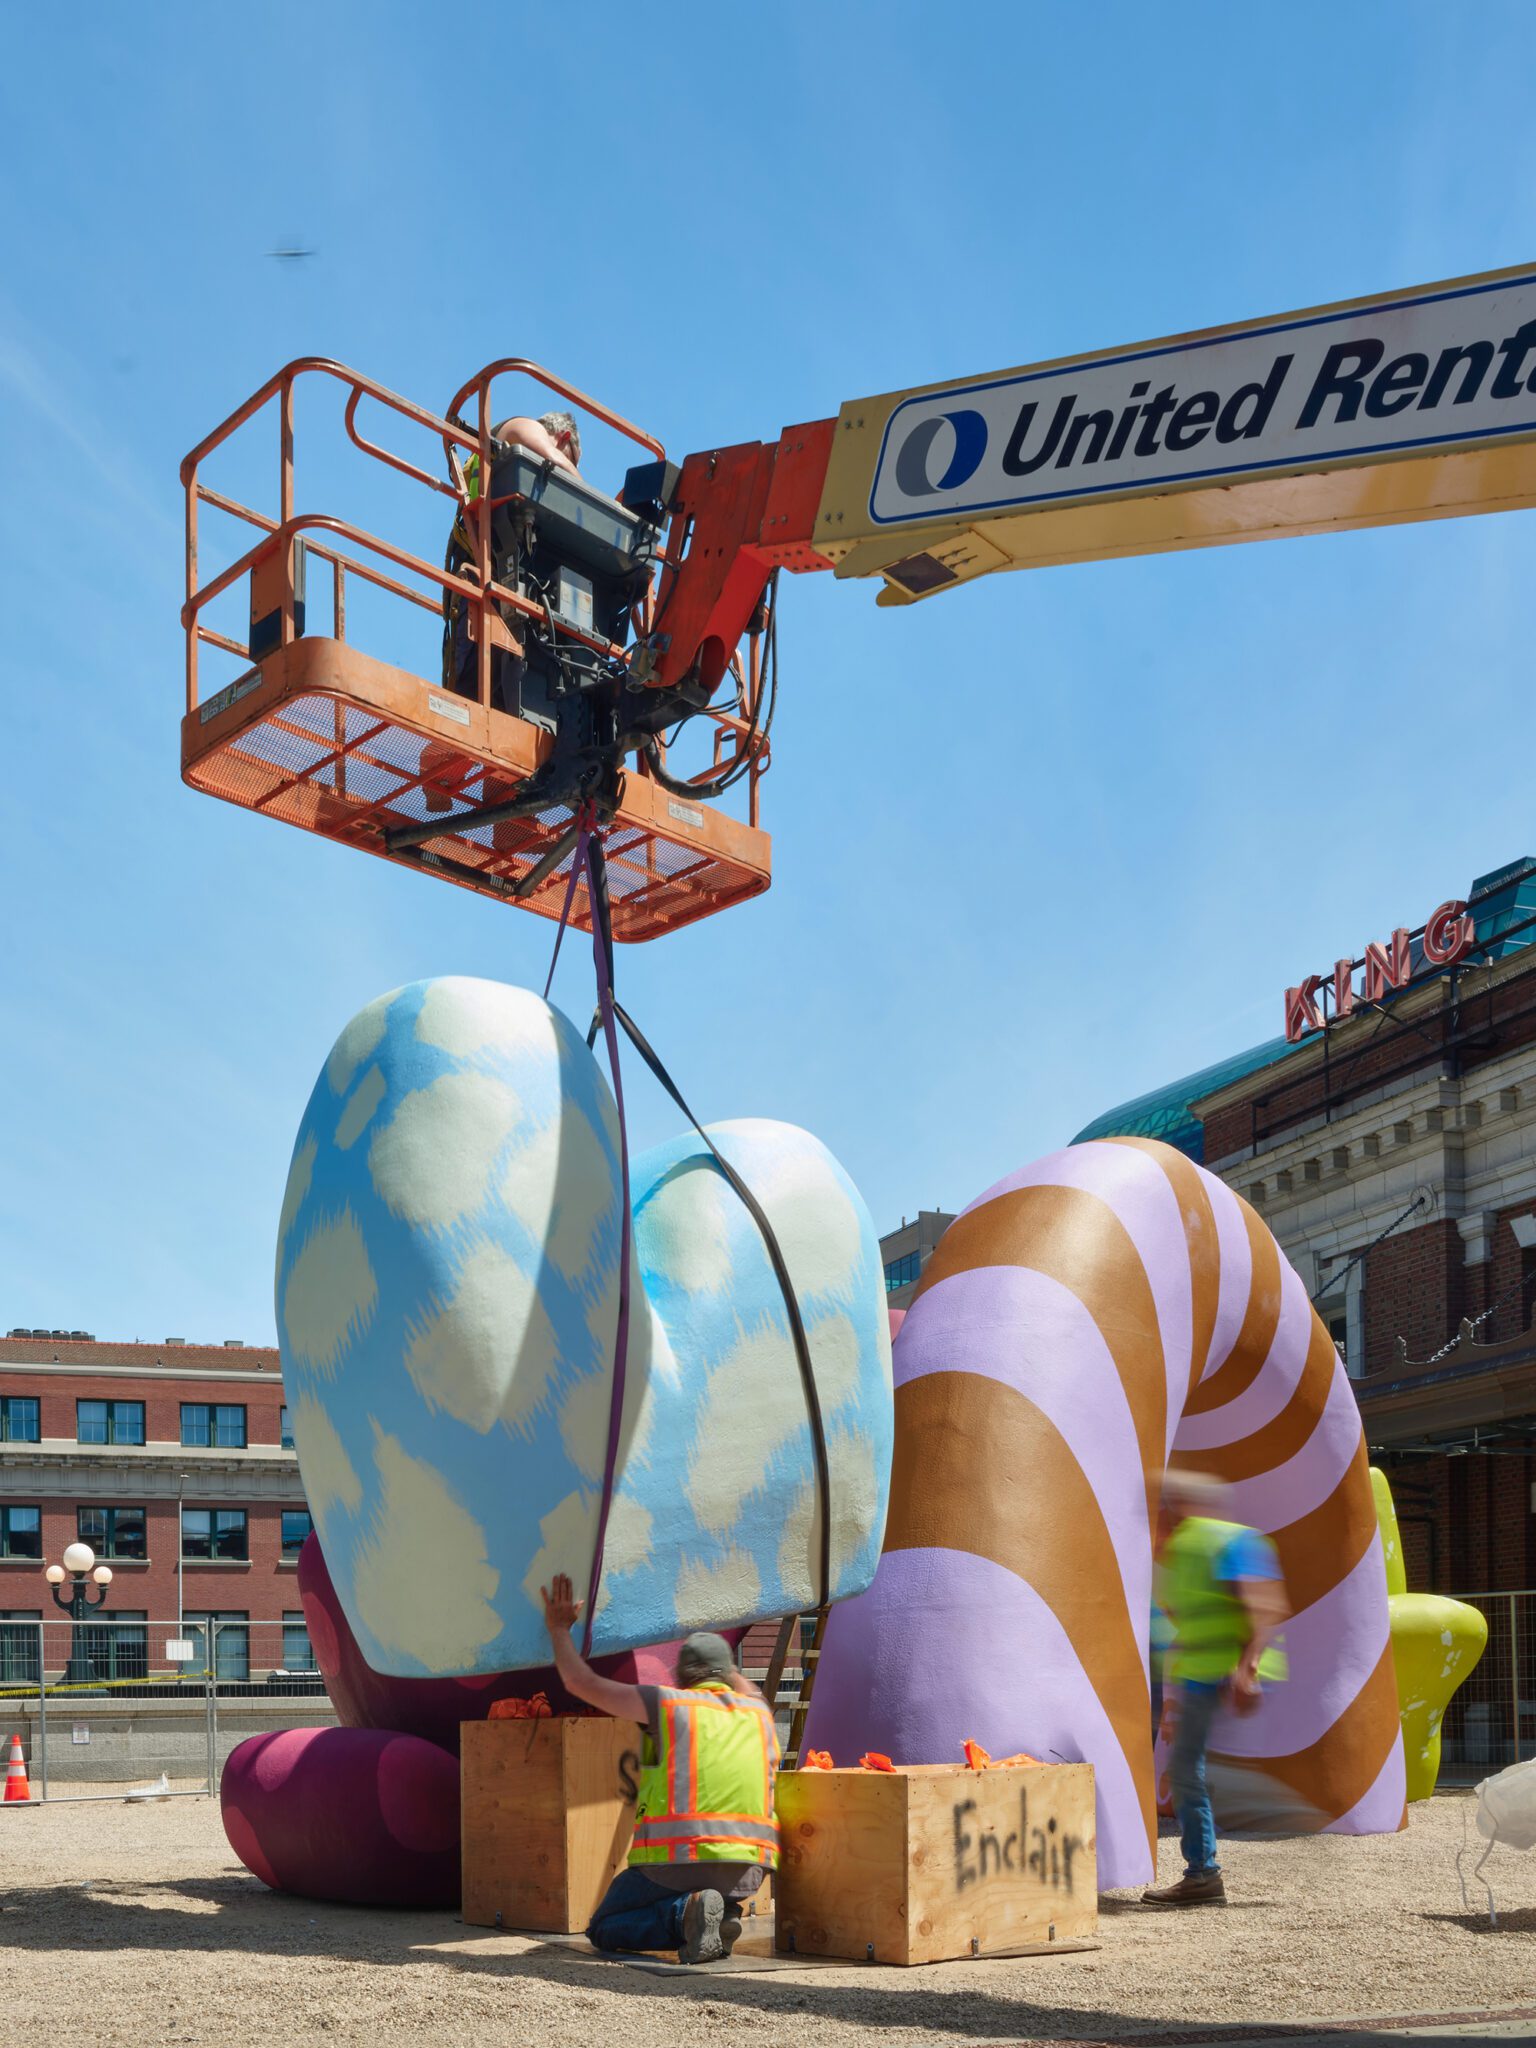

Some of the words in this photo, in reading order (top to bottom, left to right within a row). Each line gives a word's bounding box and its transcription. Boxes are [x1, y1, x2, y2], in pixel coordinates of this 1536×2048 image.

[1002, 354, 1293, 476] United
[1295, 319, 1536, 430] Rent
[1285, 900, 1475, 1043] KING
[953, 1785, 1083, 1895] Enclair
